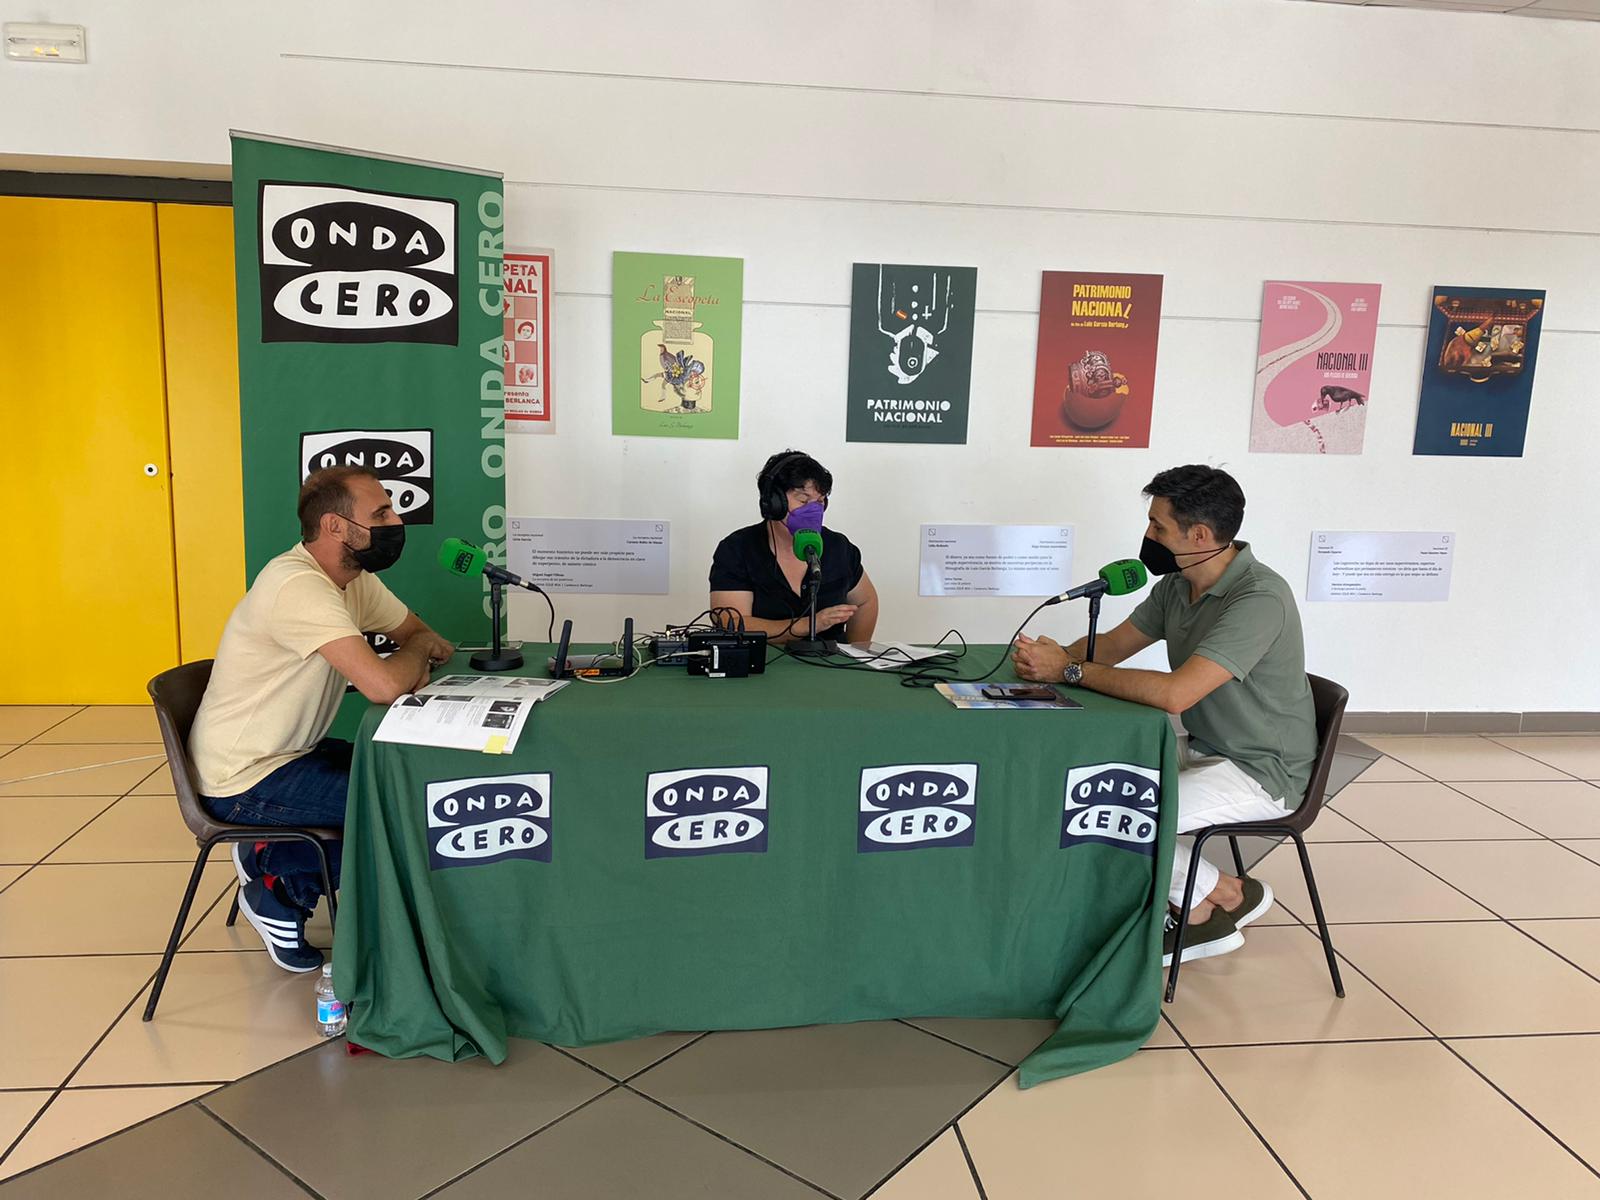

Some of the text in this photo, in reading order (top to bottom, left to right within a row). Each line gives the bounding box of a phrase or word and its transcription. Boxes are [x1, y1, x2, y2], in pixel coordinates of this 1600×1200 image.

[290, 218, 429, 255] ONDA
[300, 279, 431, 317] CERO
[1072, 284, 1132, 299] PATRIMONIO
[1071, 300, 1133, 319] NACIONAL
[477, 190, 505, 479] ONDA CERO
[1316, 352, 1369, 371] NACIONAL III
[867, 399, 951, 411] PATRIMONIO
[874, 411, 943, 423] NACIONAL
[1450, 422, 1494, 438] NACIONAL III
[320, 451, 414, 469] ONDA
[663, 785, 750, 806] ONDA
[876, 781, 959, 801] ONDA
[1079, 778, 1155, 803] ONDA
[443, 791, 533, 816] ONDA
[668, 819, 750, 842] CERO
[880, 814, 958, 836] CERO
[1079, 810, 1151, 839] CERO
[451, 826, 535, 852] CERO
